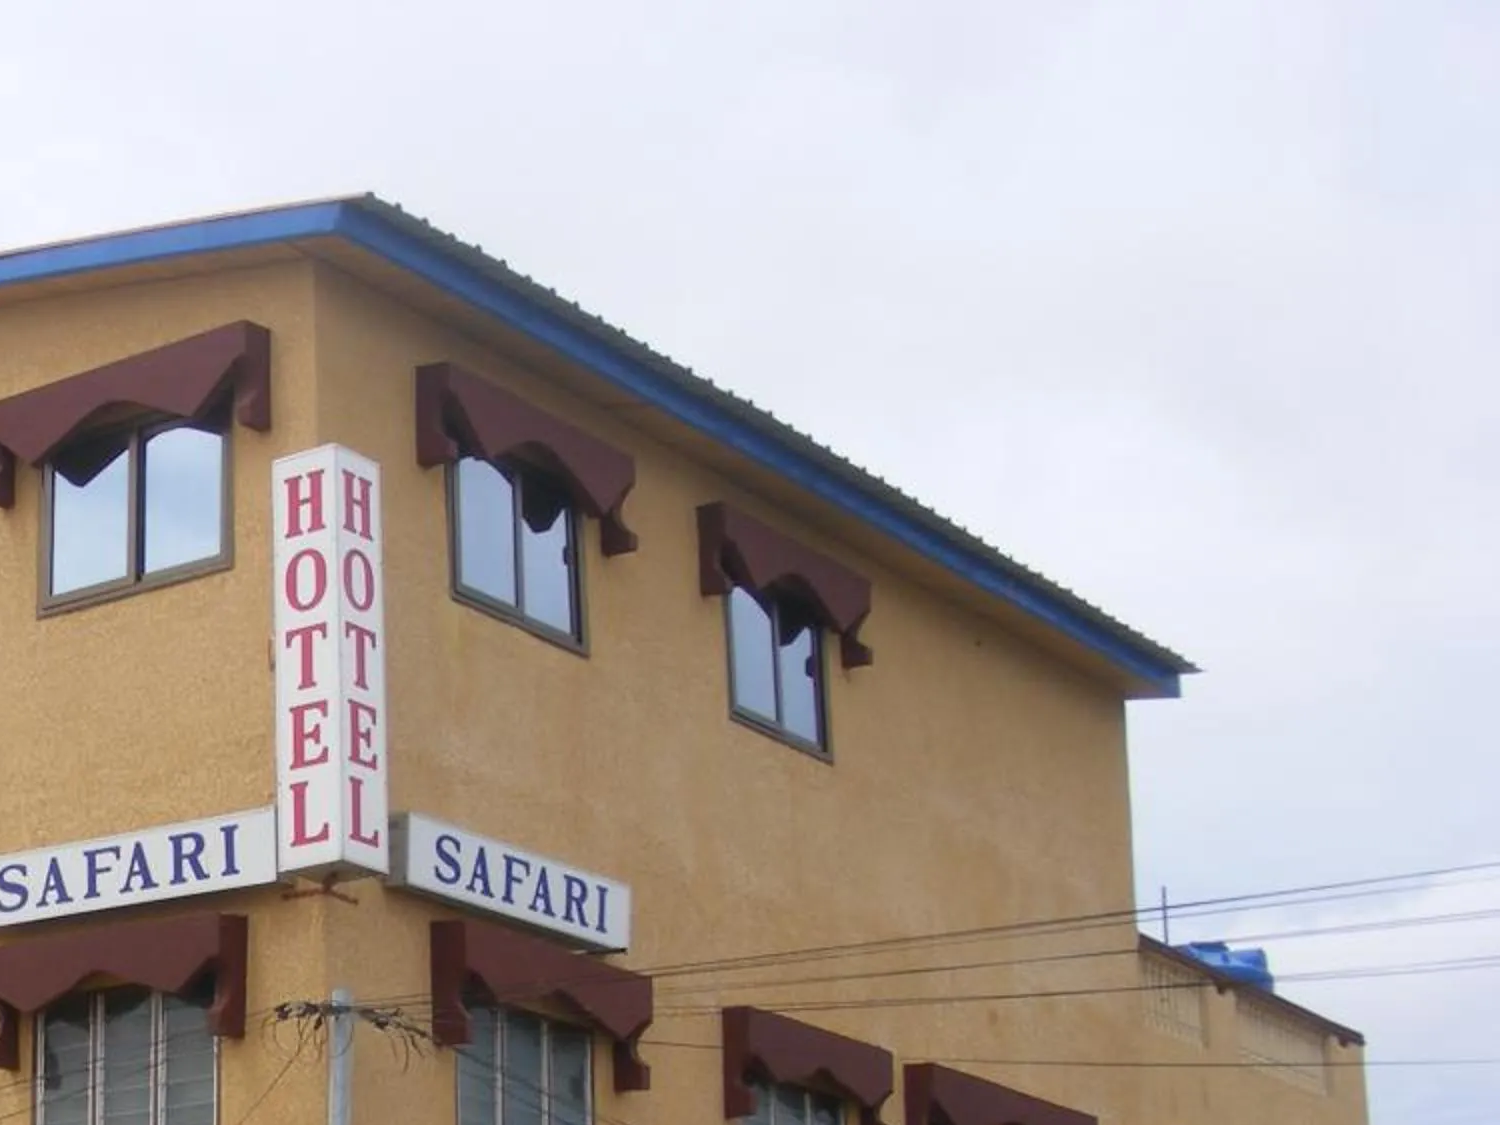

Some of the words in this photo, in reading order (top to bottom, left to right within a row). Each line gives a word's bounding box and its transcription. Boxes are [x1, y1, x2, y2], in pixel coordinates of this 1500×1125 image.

[283, 468, 330, 848] HOTEL
[341, 469, 380, 849] HOTEL
[432, 832, 610, 936] SAFARI
